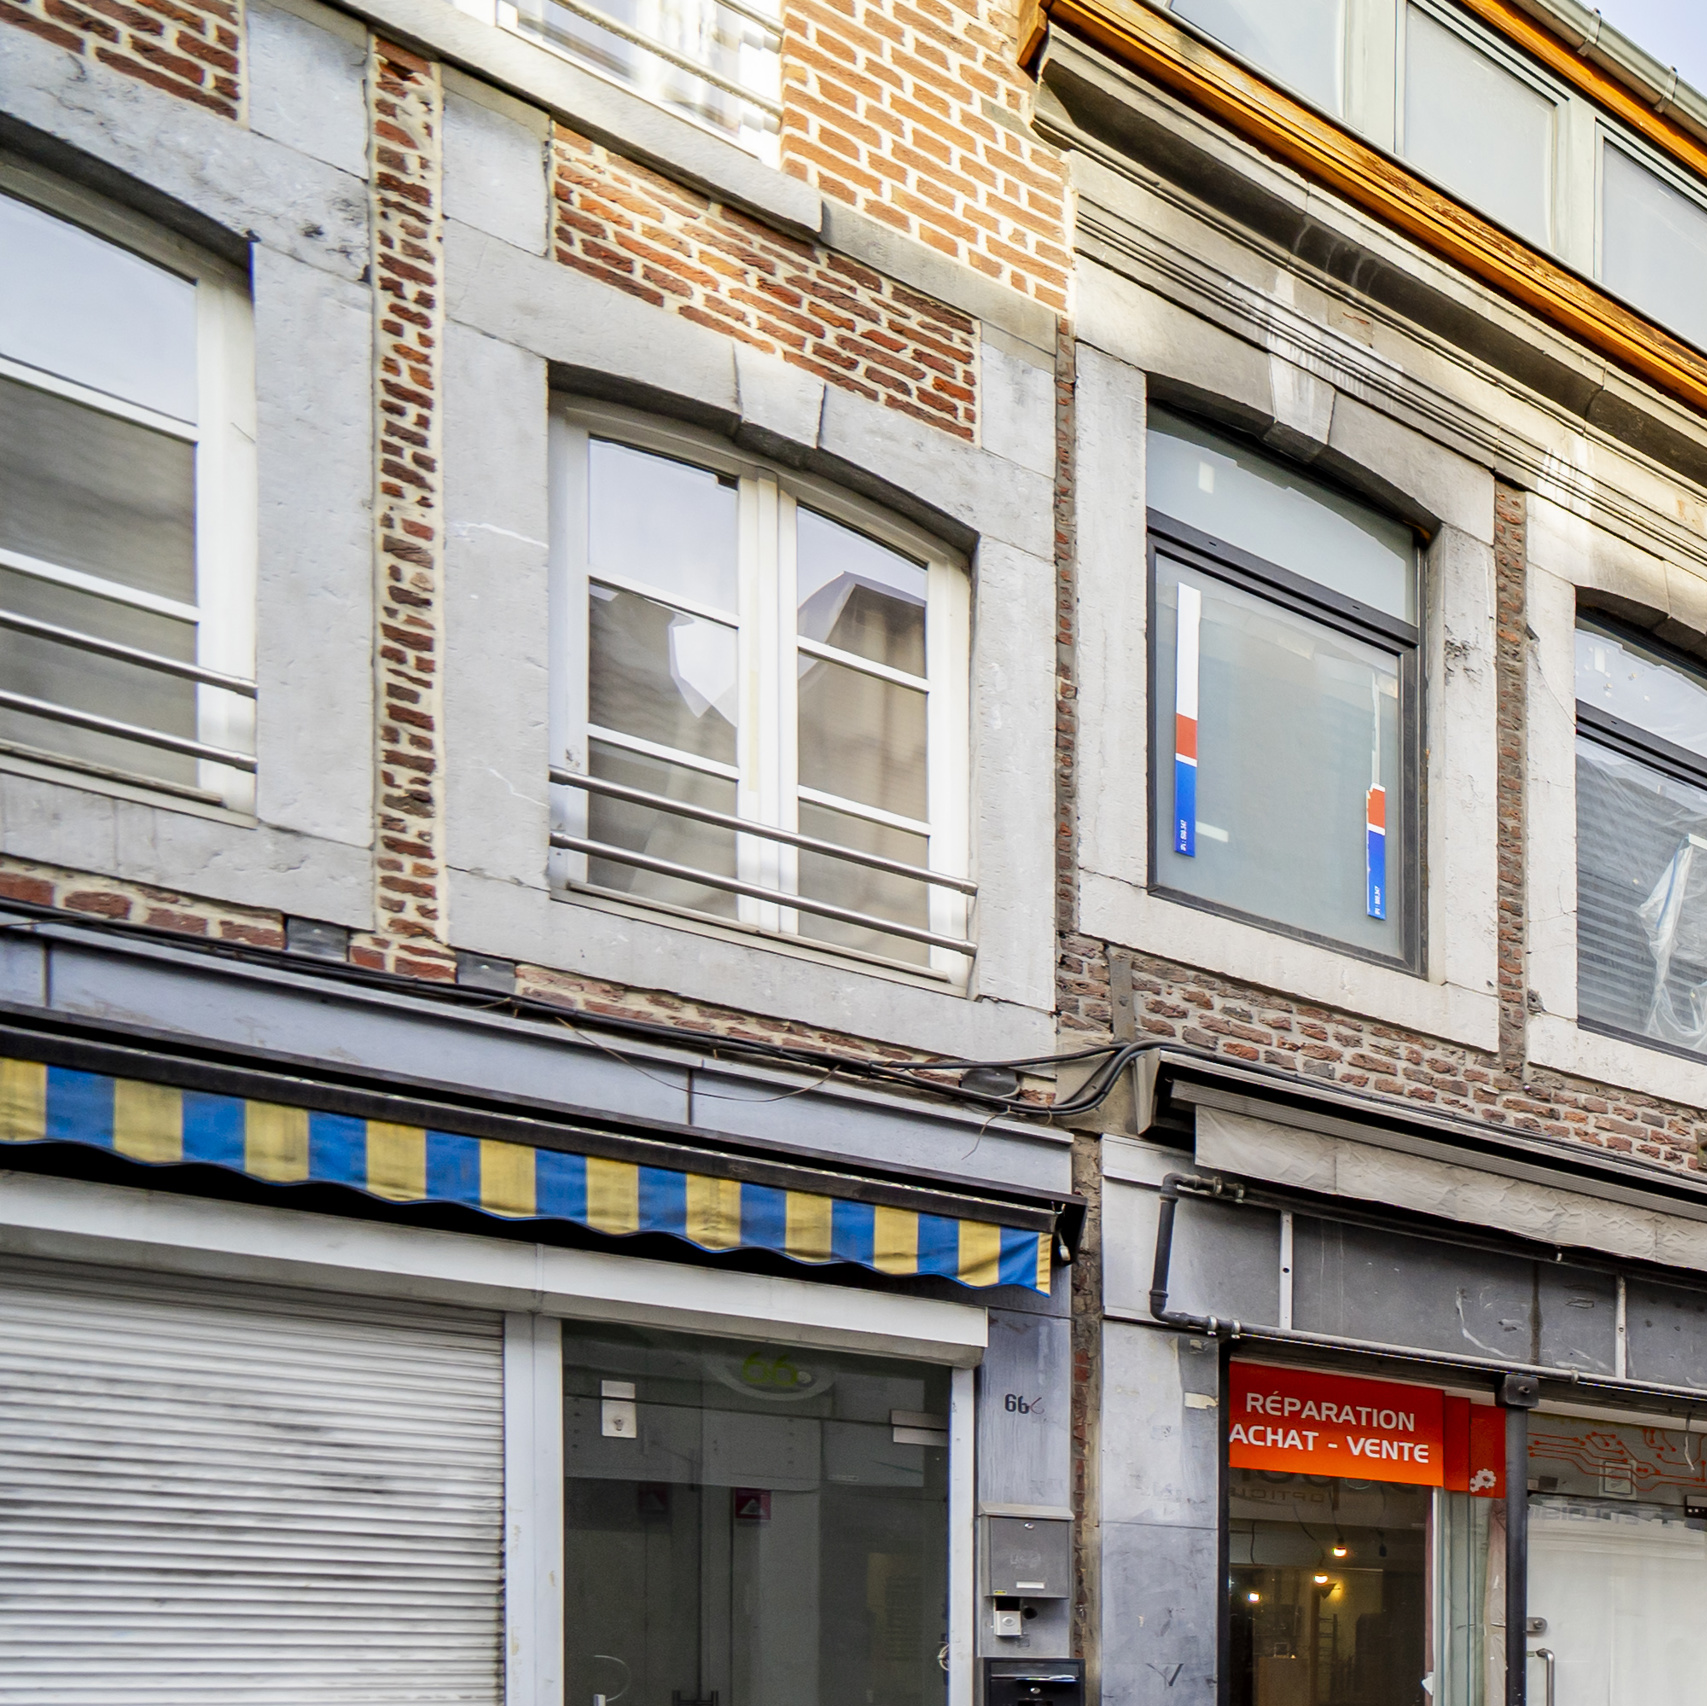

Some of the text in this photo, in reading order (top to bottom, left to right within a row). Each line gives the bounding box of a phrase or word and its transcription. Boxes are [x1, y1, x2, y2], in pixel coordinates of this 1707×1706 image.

[1246, 1390, 1415, 1432] RÉPARATION
[1229, 1424, 1319, 1451] ACHAT
[1346, 1435, 1430, 1464] VENTE
